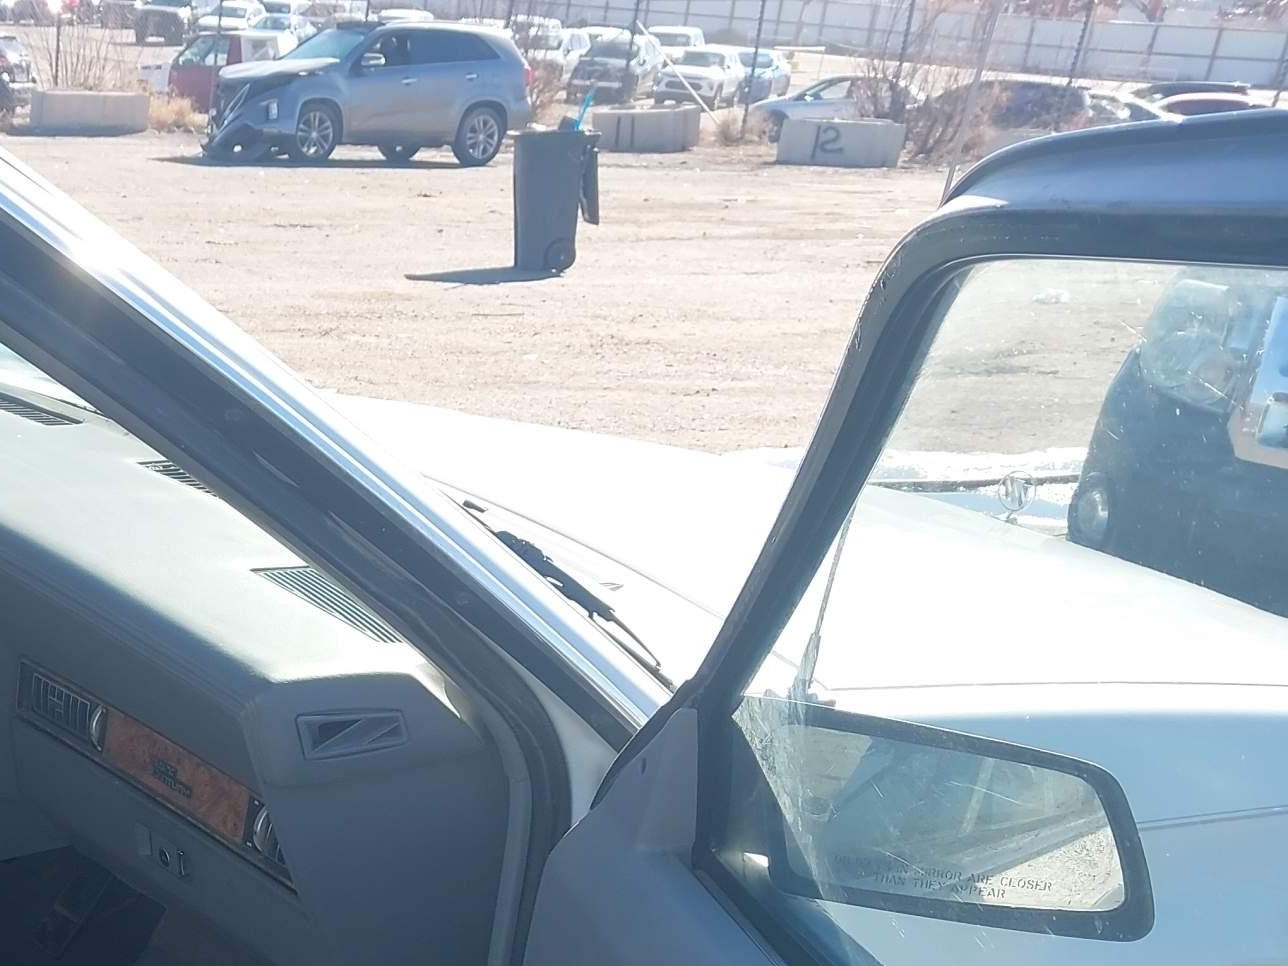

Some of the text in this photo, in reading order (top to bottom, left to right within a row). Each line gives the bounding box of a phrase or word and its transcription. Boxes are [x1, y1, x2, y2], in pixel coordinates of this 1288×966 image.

[810, 125, 844, 160] 12
[913, 878, 946, 890] THEY
[968, 873, 993, 886] ARE
[1000, 876, 1053, 892] CLOSER
